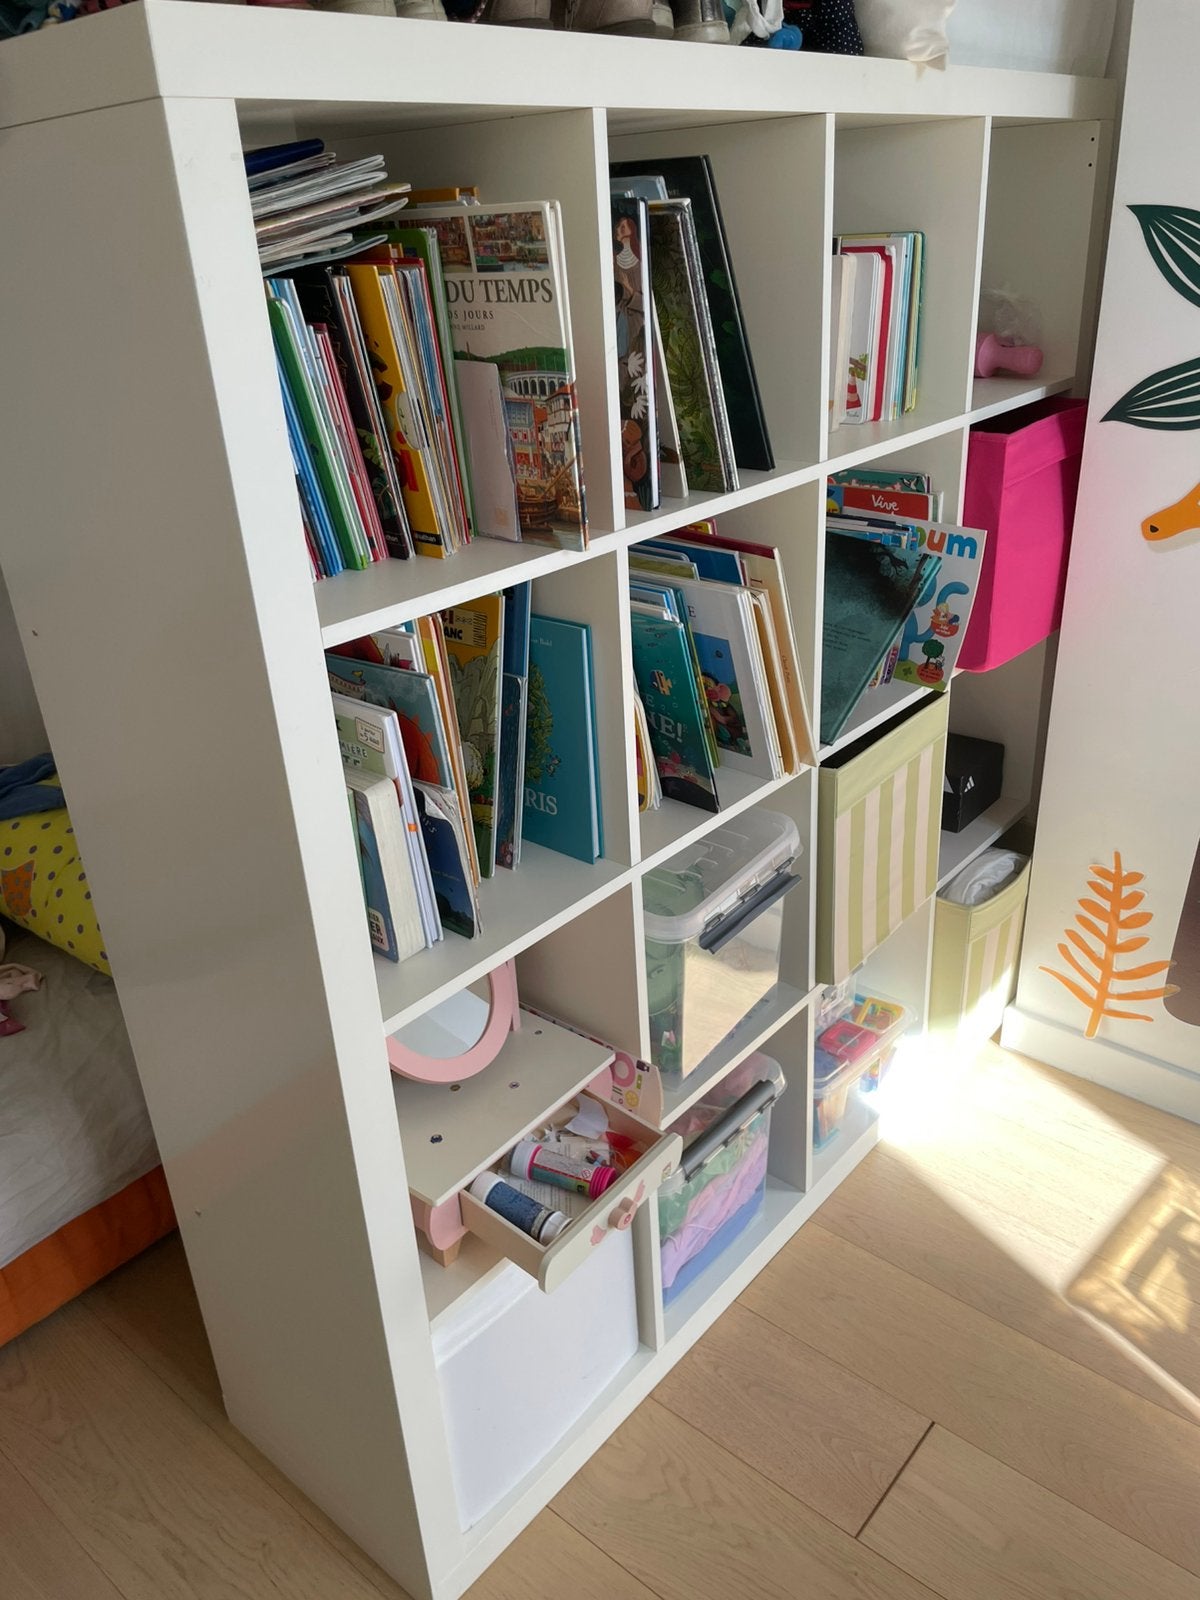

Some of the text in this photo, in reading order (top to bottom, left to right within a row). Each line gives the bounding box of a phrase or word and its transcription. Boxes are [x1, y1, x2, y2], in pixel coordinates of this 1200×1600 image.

[445, 278, 553, 304] DU TEMPS
[463, 310, 494, 321] JOURS
[871, 494, 900, 511] Vive
[444, 625, 463, 641] ANC
[525, 787, 558, 816] RIS
